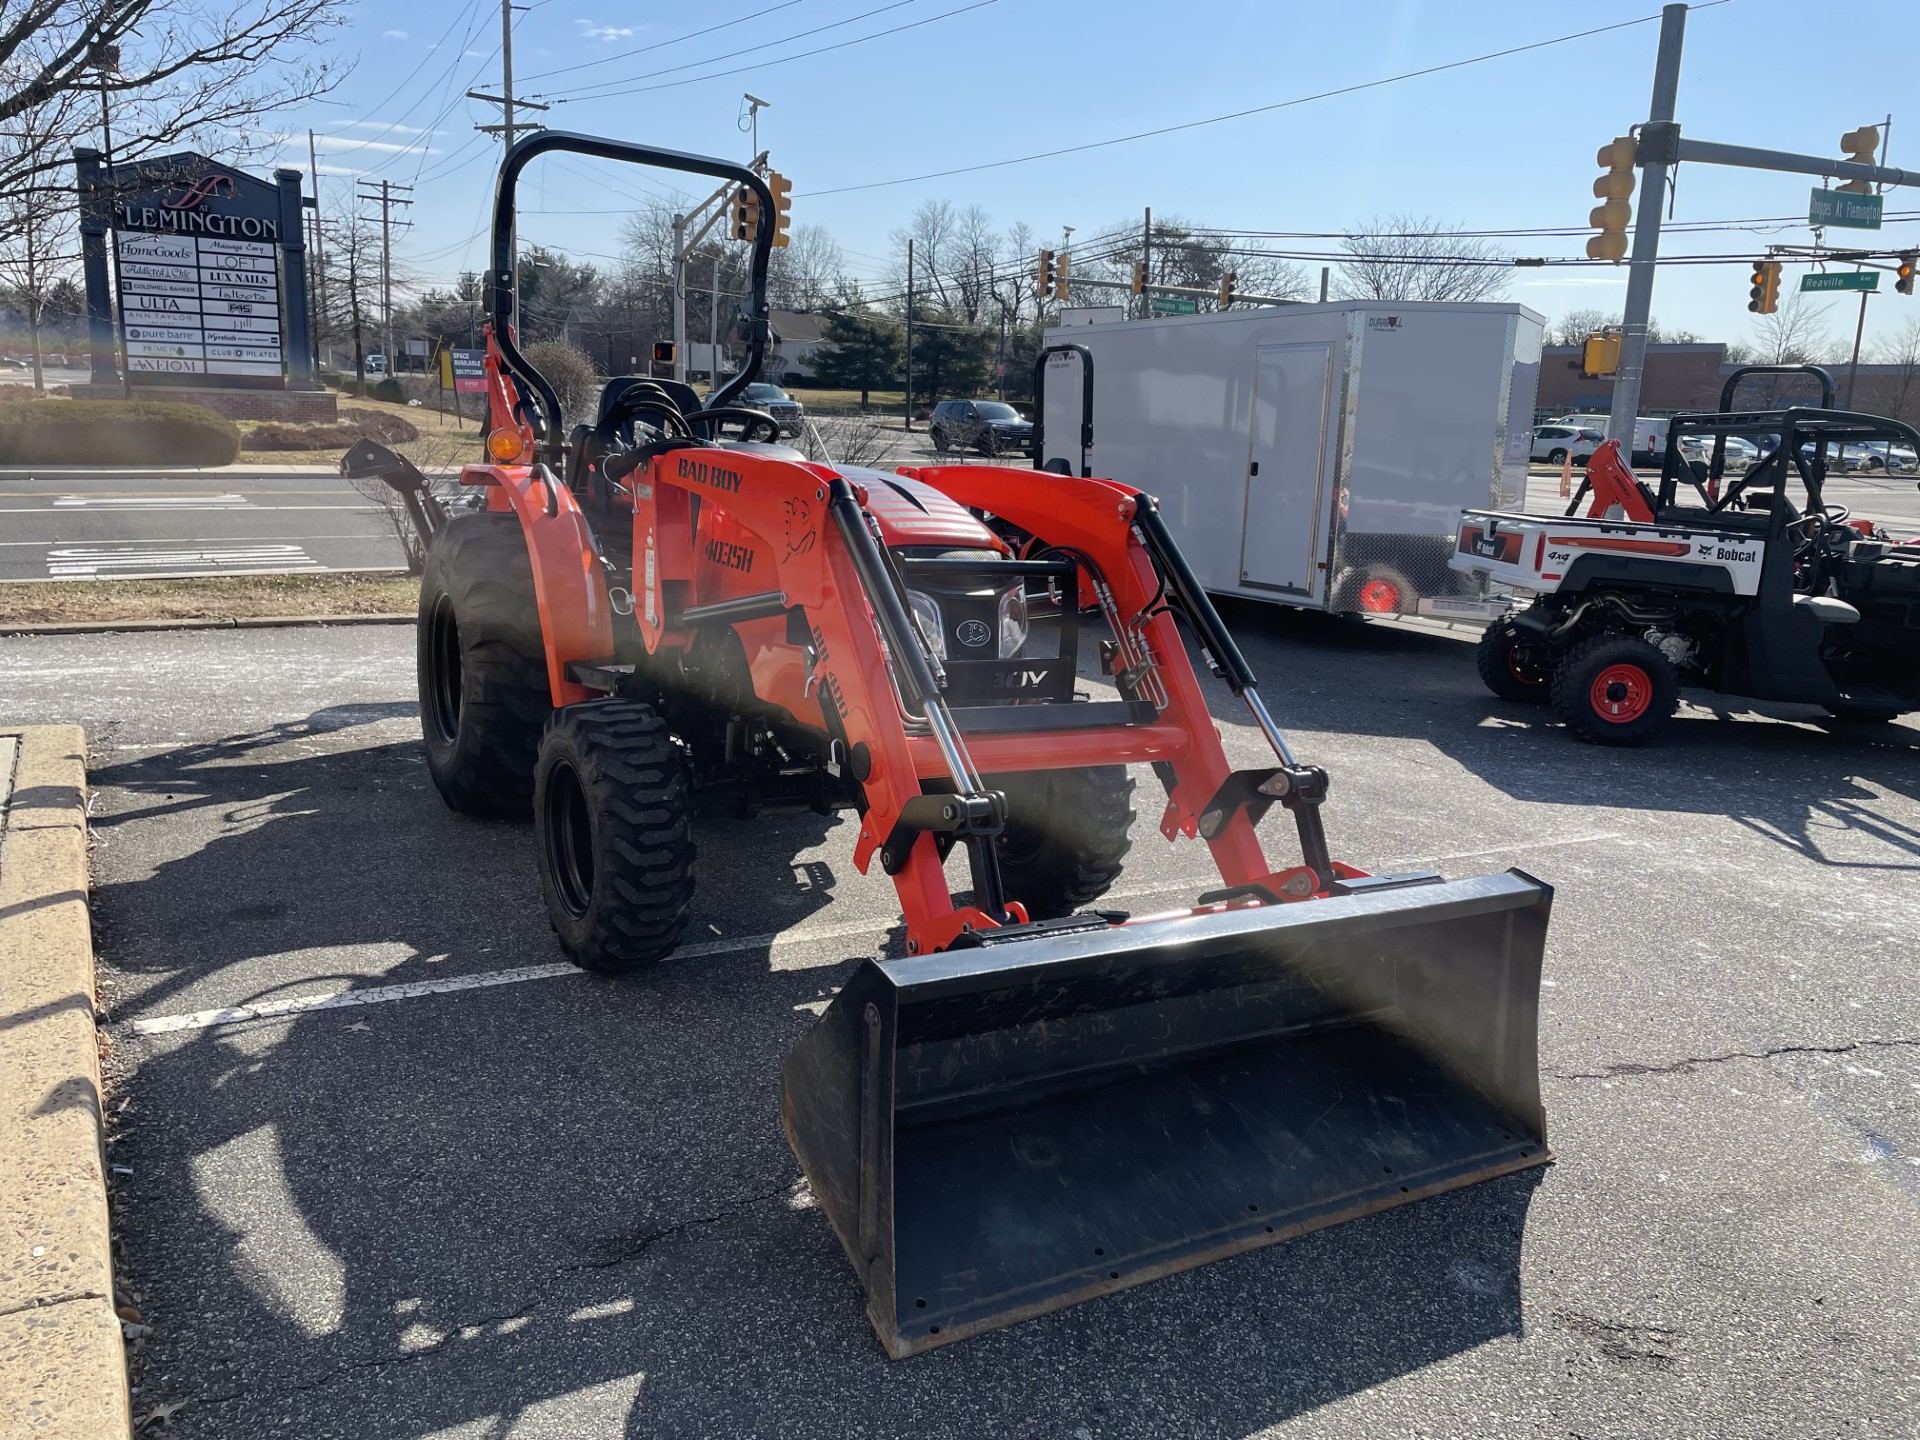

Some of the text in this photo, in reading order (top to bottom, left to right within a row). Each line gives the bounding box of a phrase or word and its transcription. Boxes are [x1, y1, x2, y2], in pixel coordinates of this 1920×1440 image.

[199, 204, 208, 212] AT
[1810, 197, 1880, 225] Shoppes At Flemington
[115, 205, 279, 239] FLEMINGTON
[120, 243, 190, 259] HomeGoods
[209, 240, 243, 252] Massage
[216, 255, 259, 270] LOFT
[124, 264, 164, 276] Addicted
[209, 271, 268, 284] LUX NAILS
[1806, 274, 1872, 287] Reaville Ave
[169, 285, 195, 293] BANKER
[211, 286, 268, 300] Talbots
[140, 297, 180, 310] ULTA
[228, 303, 252, 314] F45
[155, 313, 193, 321] TAYLOR
[167, 330, 193, 339] barre
[678, 457, 743, 494] BAD BOY
[705, 539, 754, 574] 4035H
[1548, 551, 1571, 561] 4x4
[1717, 548, 1756, 562] Bobcat
